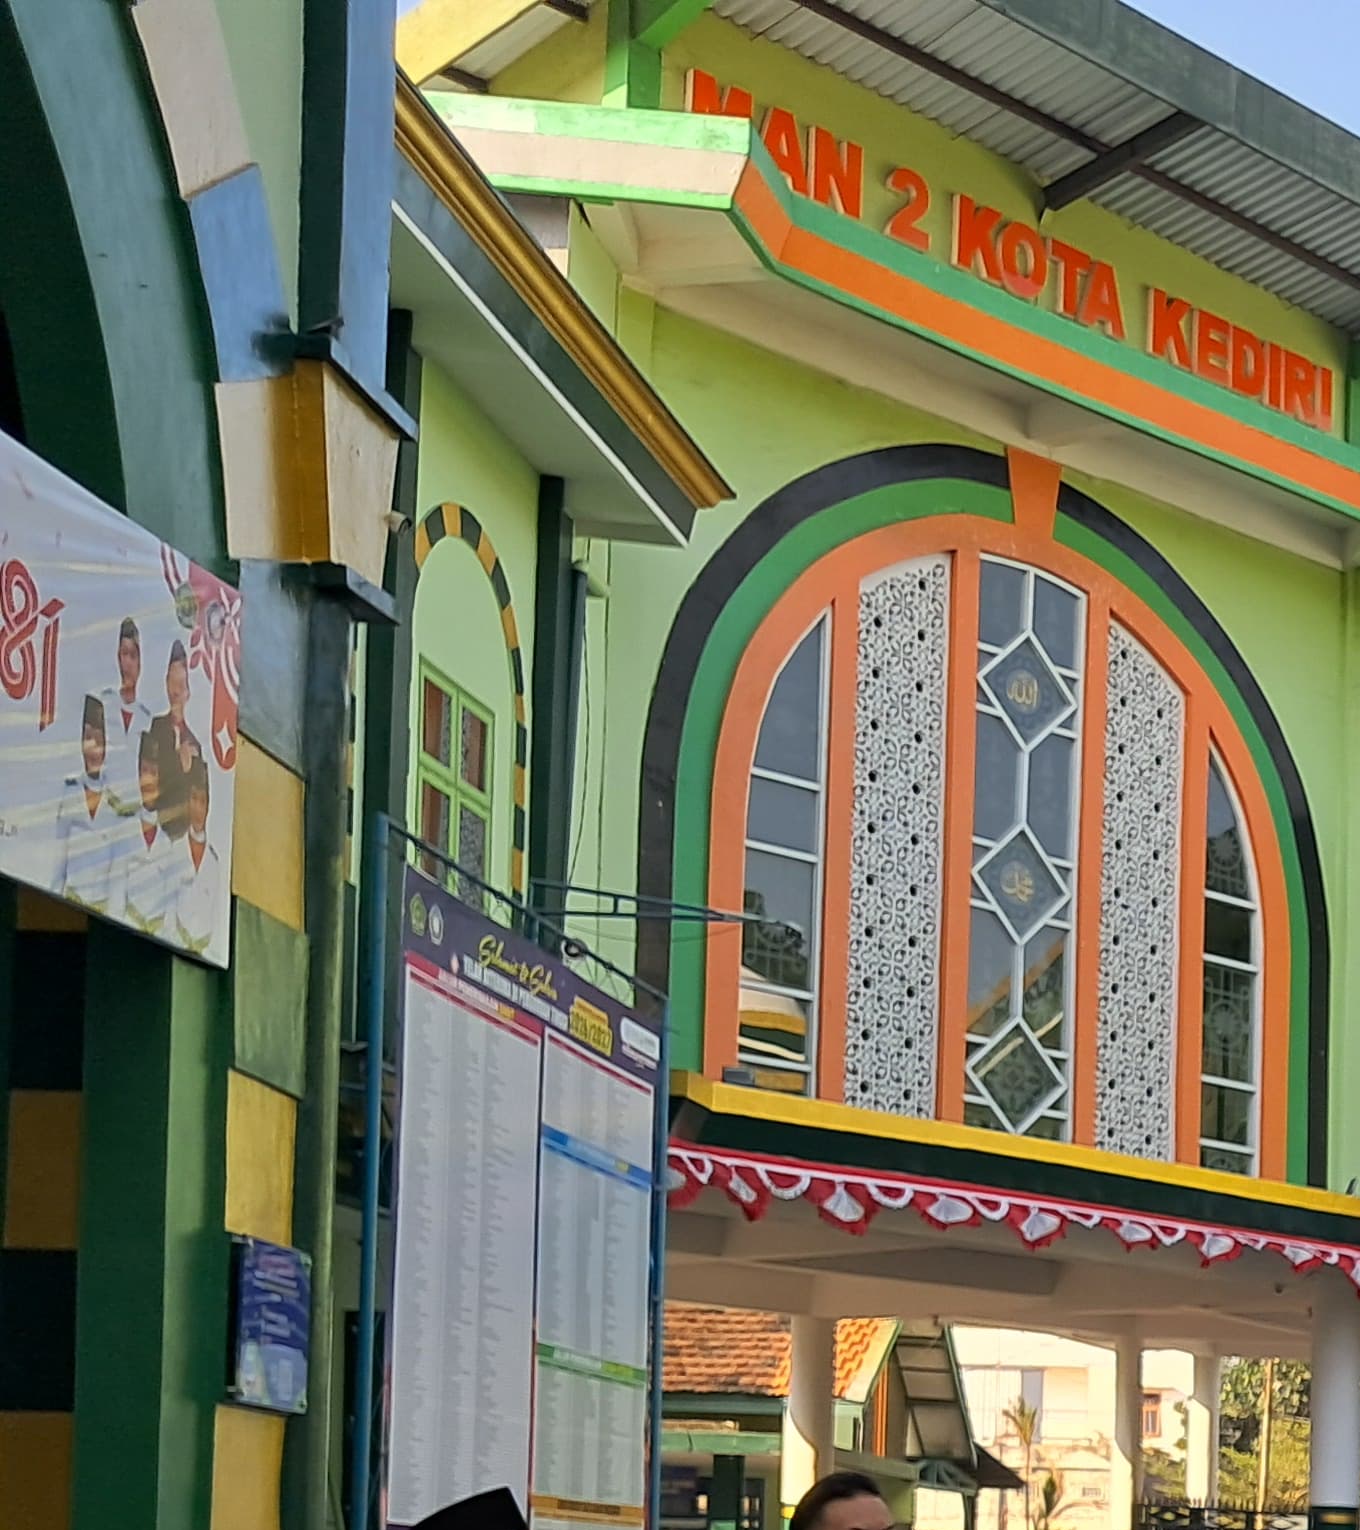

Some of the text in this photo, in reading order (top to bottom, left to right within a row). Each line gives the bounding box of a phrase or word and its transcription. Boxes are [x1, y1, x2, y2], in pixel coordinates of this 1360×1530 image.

[684, 68, 1335, 433] MAN 2 KOTA KEDIRI
